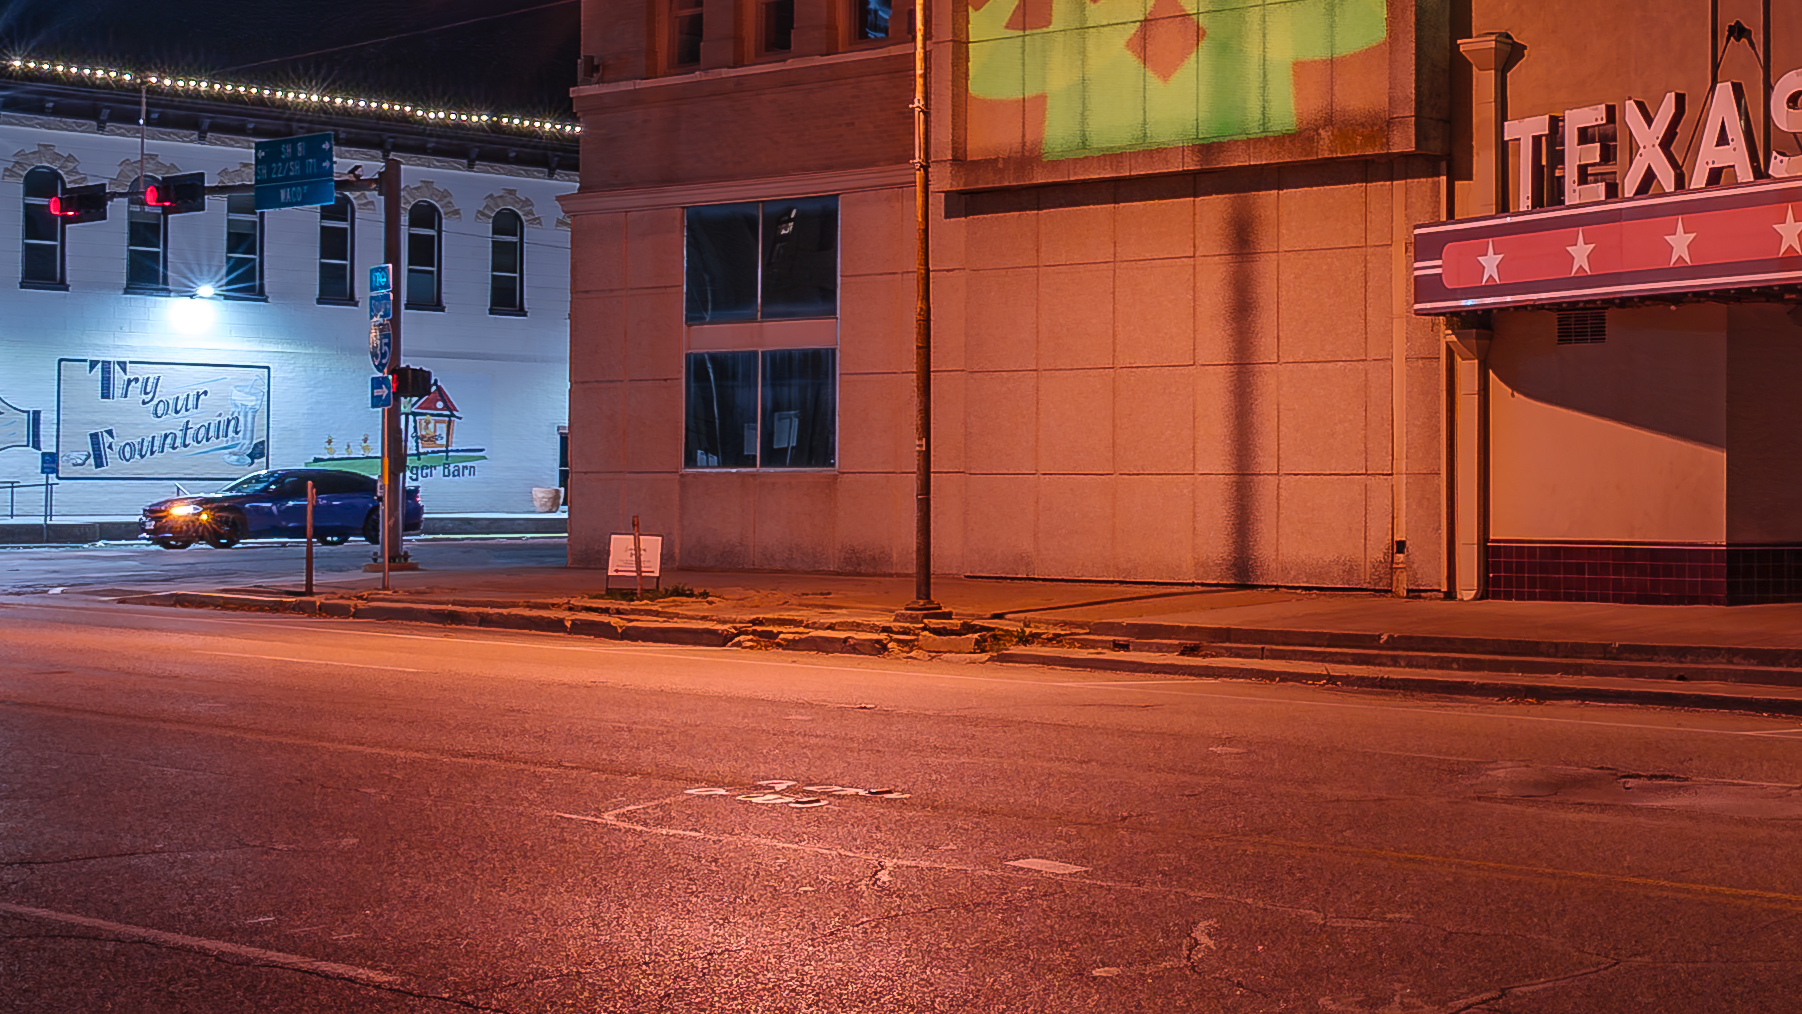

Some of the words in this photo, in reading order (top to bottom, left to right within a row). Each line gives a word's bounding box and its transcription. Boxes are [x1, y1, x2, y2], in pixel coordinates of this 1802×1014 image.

[89, 360, 161, 405] Try
[152, 389, 208, 418] our
[89, 412, 241, 469] Fountain
[443, 462, 476, 478] Barn
